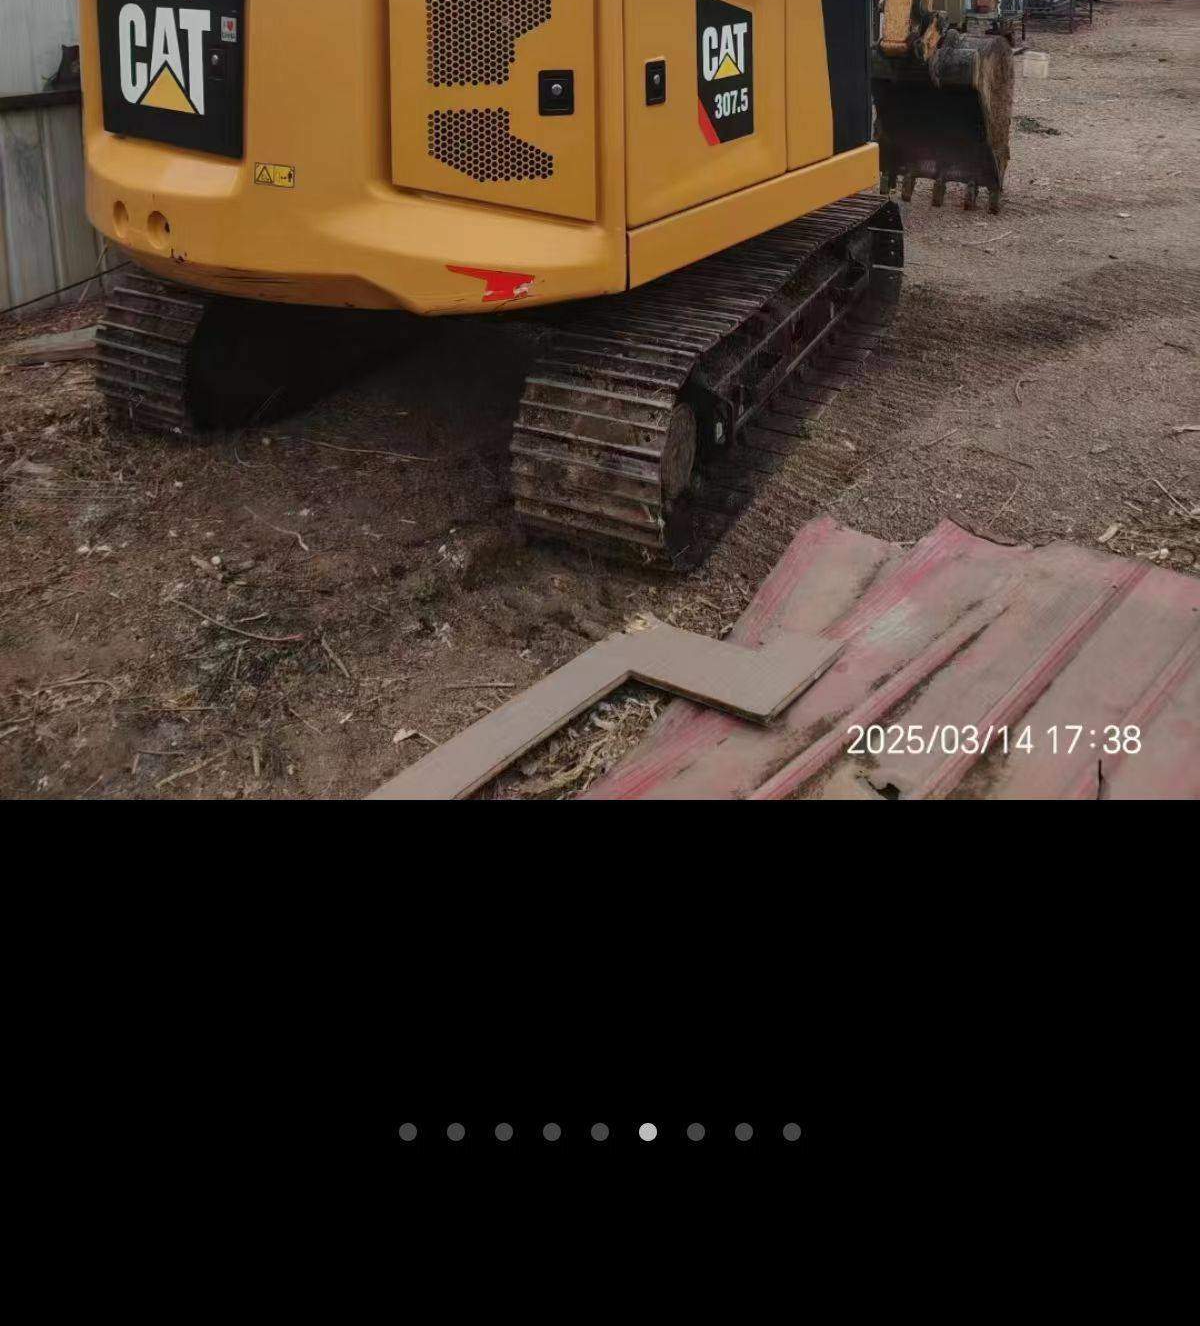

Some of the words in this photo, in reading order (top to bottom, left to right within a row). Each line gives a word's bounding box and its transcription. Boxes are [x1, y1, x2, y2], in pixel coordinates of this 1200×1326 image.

[119, 3, 211, 115] CAT
[702, 22, 748, 81] CAT
[714, 87, 749, 119] 307.5
